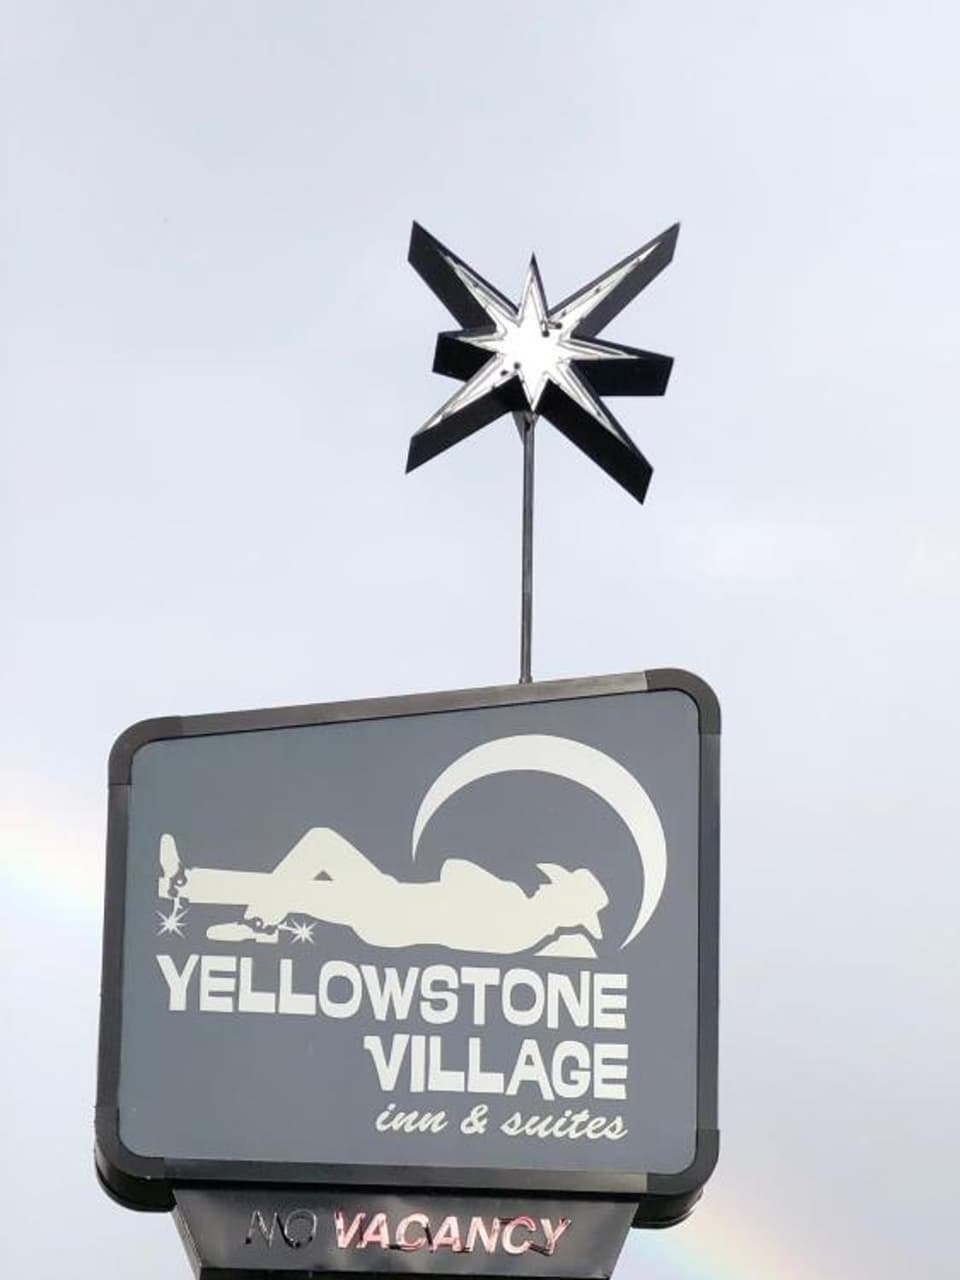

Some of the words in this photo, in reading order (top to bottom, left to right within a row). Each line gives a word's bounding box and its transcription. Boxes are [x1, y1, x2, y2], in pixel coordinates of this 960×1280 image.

[156, 953, 629, 1031] YELLOWSTONE
[363, 1033, 629, 1101] VILLAGE
[375, 1103, 448, 1134] inn
[460, 1103, 489, 1135] &
[499, 1108, 628, 1141] suites
[245, 1208, 318, 1248] NO
[333, 1208, 572, 1257] VACANCY
